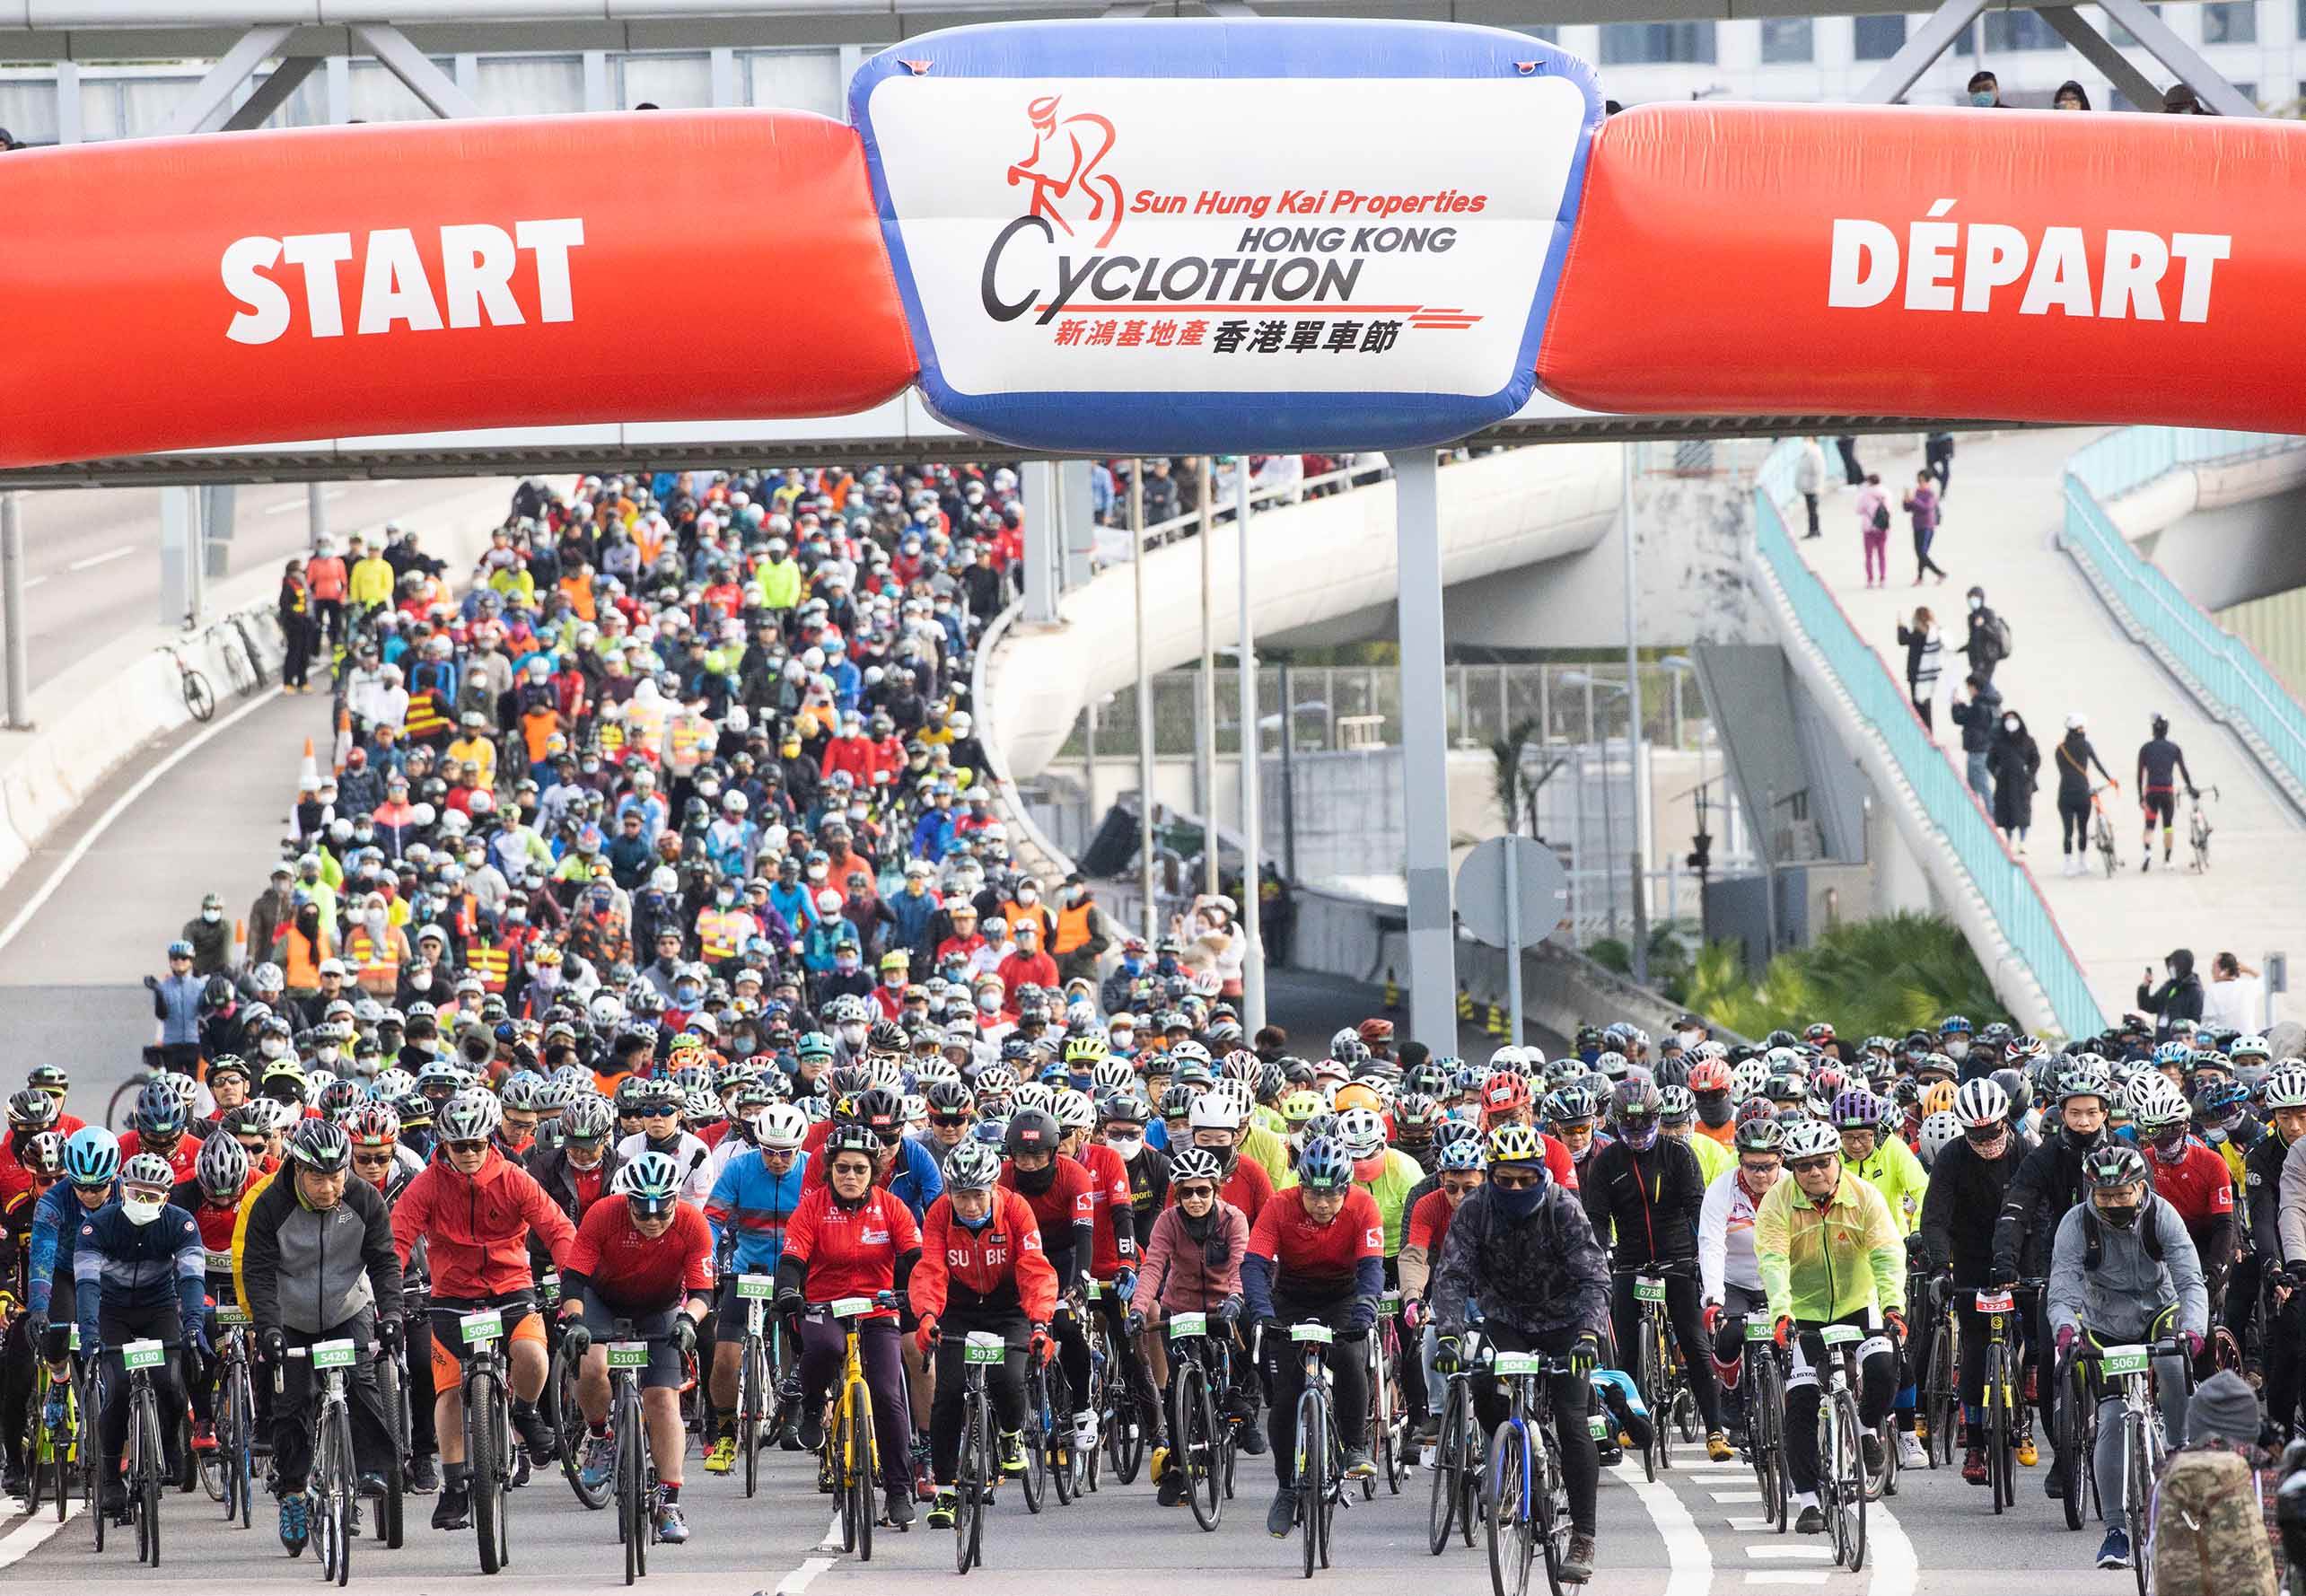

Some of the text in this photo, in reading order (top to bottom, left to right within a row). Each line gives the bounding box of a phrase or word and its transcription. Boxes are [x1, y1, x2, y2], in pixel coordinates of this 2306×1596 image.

[1130, 189, 1488, 219] Sun Hung Kai Properties
[1236, 226, 1458, 253] HONG KONG
[1828, 198, 2232, 324] DÉPART
[221, 218, 585, 345] START
[1054, 319, 1403, 355] 新鴻基地產 香港單車節
[948, 1249, 969, 1267] SU
[742, 1284, 768, 1294] 5127
[1639, 1286, 1662, 1297] 6738
[1981, 1302, 2008, 1311] 1229
[467, 1323, 495, 1337] 5099
[1175, 1321, 1200, 1333] 5055
[131, 1351, 159, 1364] 6180
[320, 1350, 348, 1364] 5420
[612, 1353, 642, 1364] 5101
[970, 1349, 998, 1360] 5025
[2110, 1355, 2141, 1370] 5067
